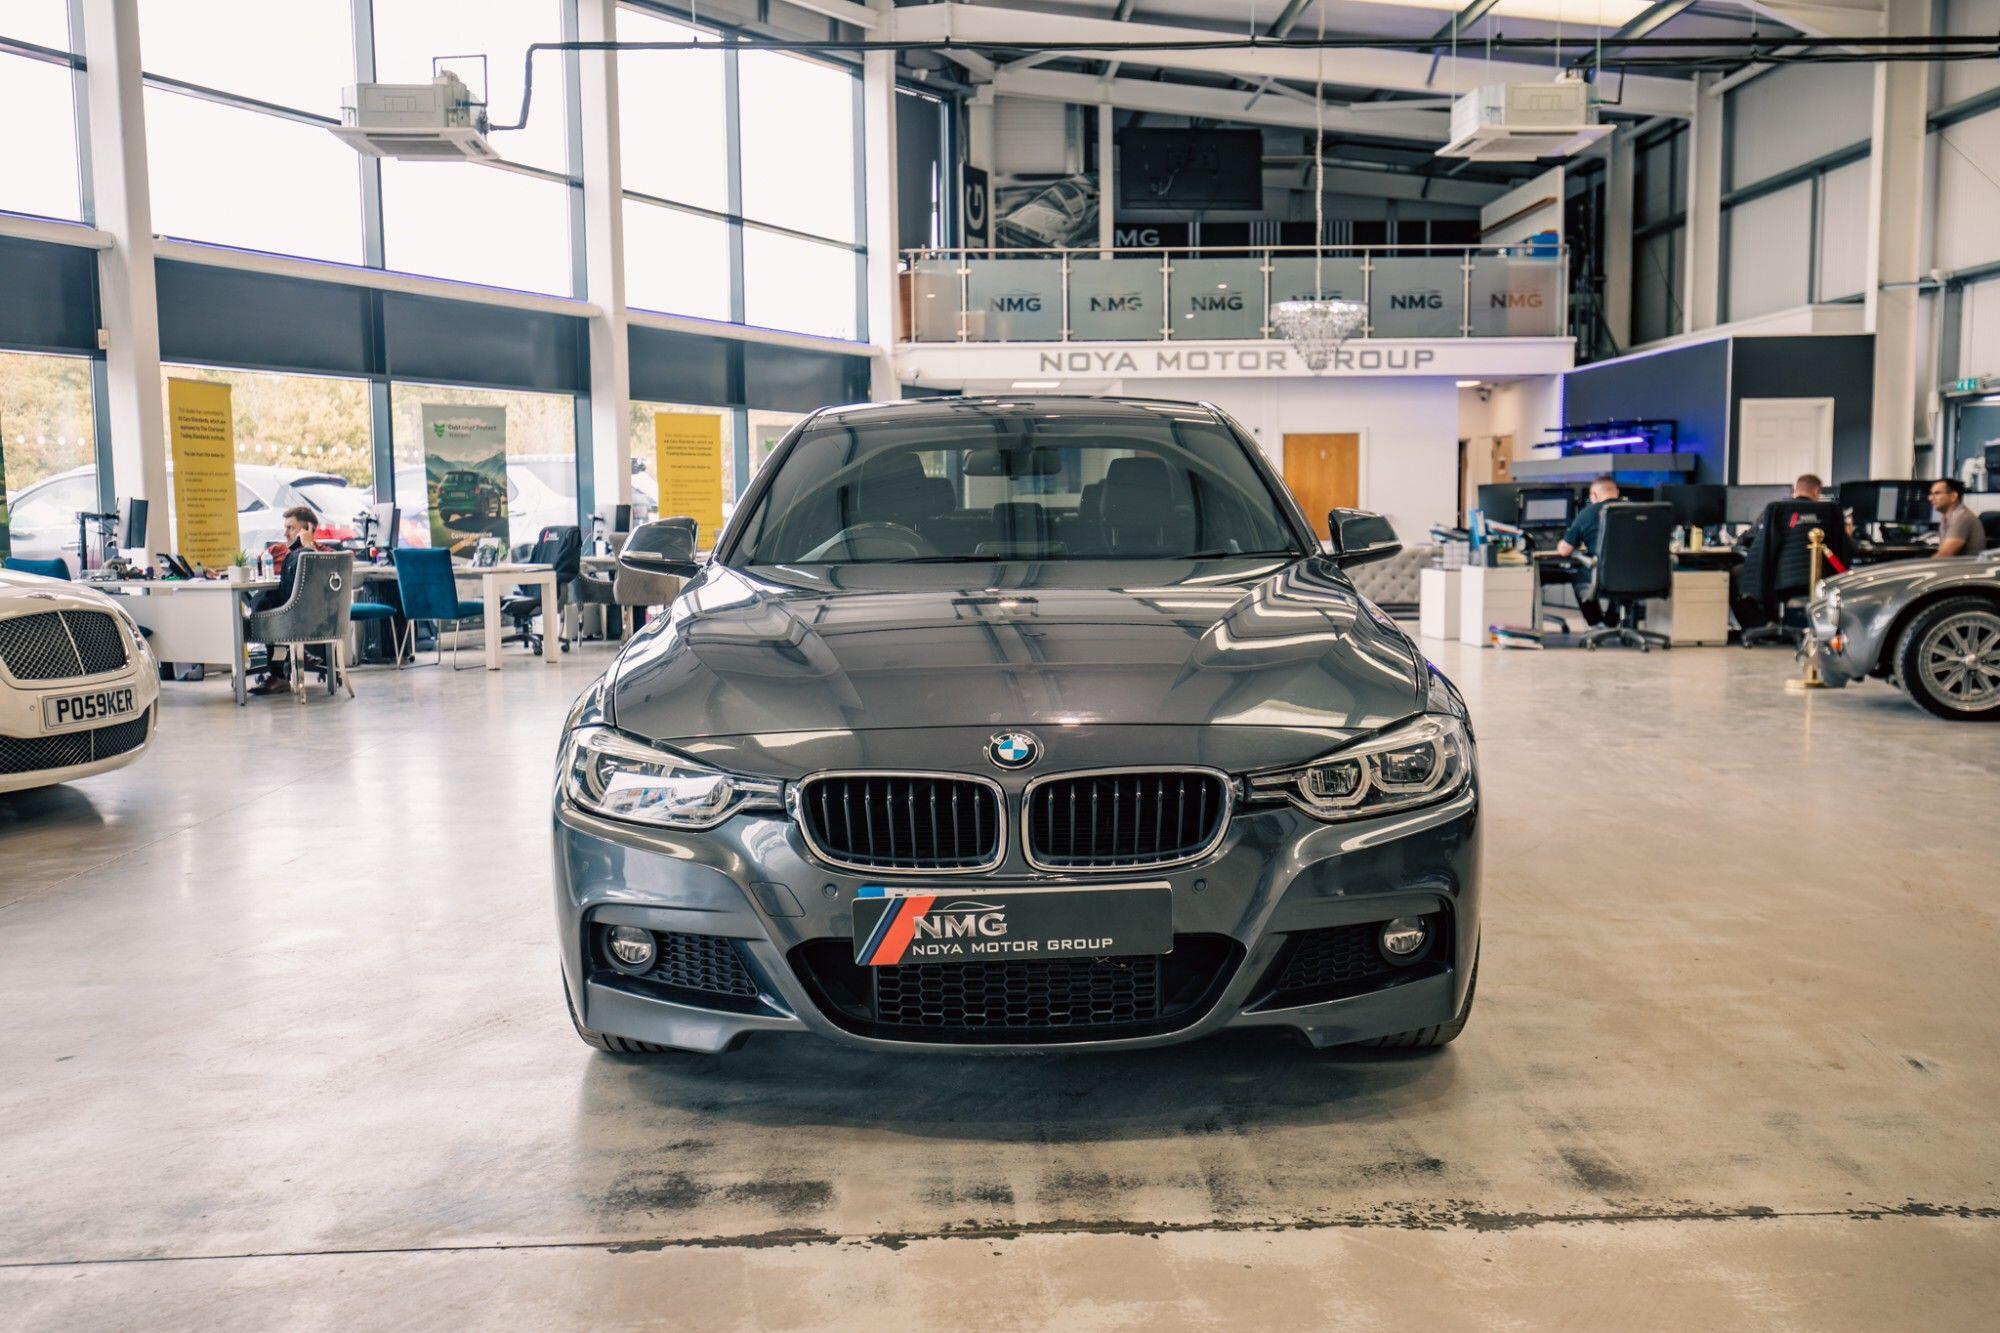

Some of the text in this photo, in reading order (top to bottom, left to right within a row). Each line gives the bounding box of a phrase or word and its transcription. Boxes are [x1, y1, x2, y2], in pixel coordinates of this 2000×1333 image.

[1115, 229, 1160, 247] MG
[990, 297, 1041, 312] NMG
[1191, 296, 1243, 311] NMG
[1390, 295, 1443, 310] NMG
[1490, 294, 1542, 309] NMG
[1040, 351, 1138, 372] NOYA
[1156, 350, 1286, 371] MOTOR
[57, 689, 133, 722] PO59KER
[913, 913, 1007, 939] NMG
[913, 937, 1113, 956] NOYA MOTOR GROUP
